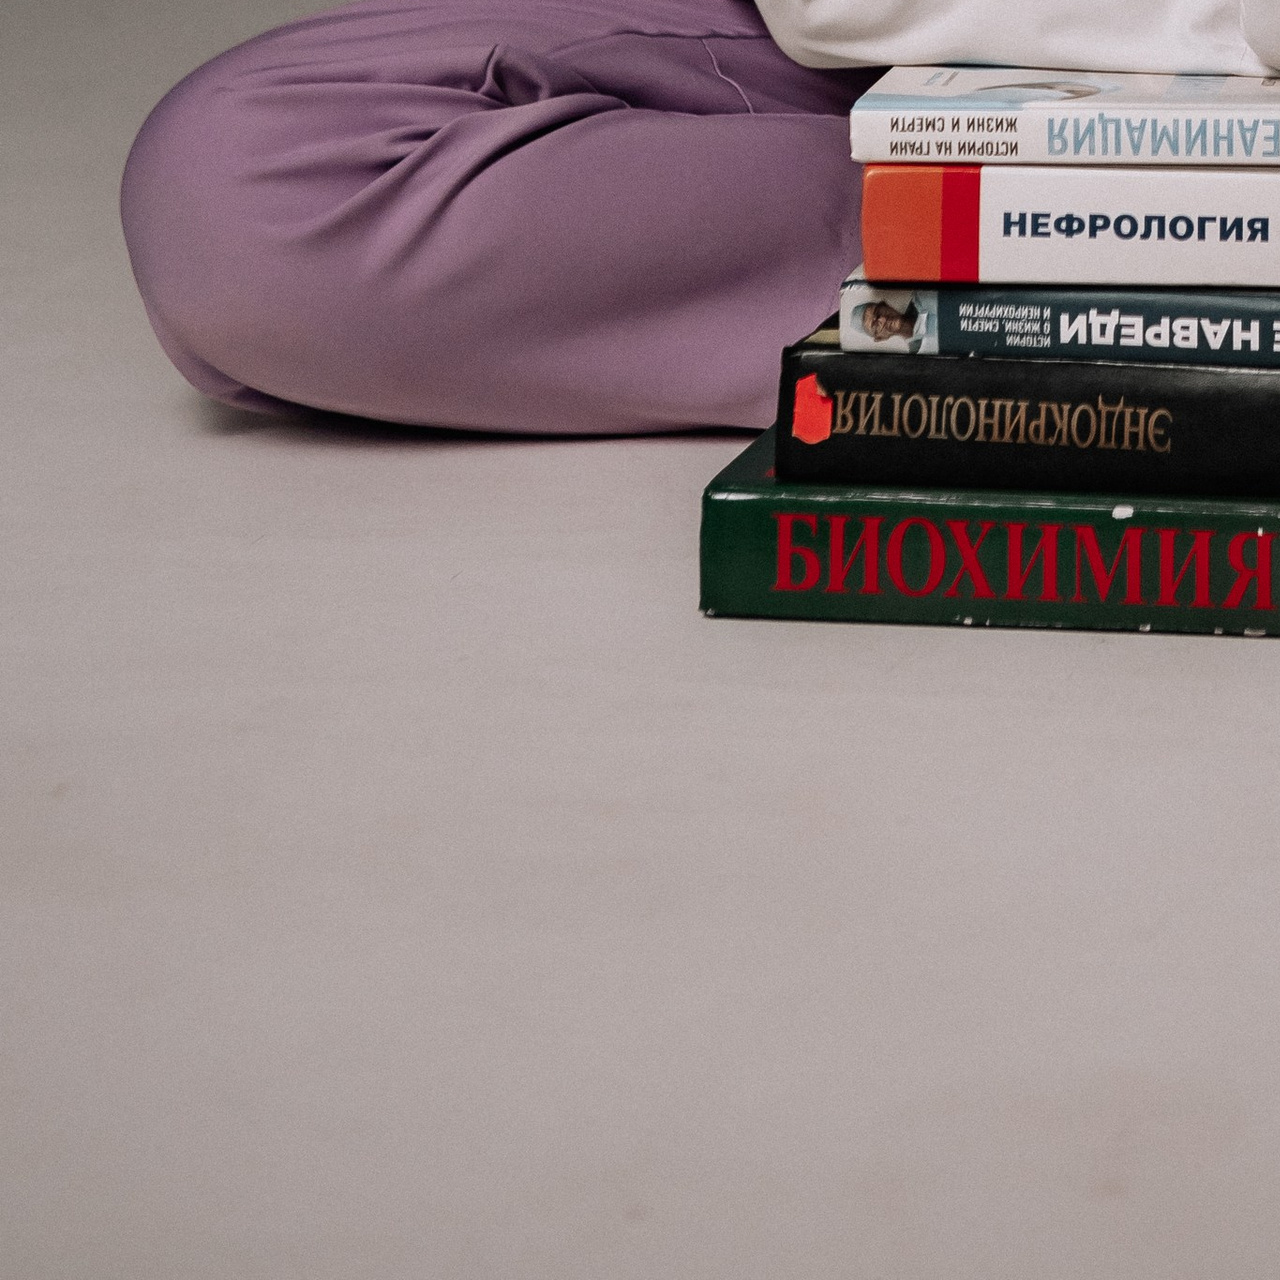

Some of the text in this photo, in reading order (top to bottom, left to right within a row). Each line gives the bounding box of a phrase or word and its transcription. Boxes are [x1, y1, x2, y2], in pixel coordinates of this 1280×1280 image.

[890, 116, 1018, 133] ЖИЗНИ И СМЕРТИ
[889, 141, 1019, 156] ИСТОРИИ НА ГРАНИ
[1003, 211, 1270, 244] НЕФРОЛОГИЯ
[959, 303, 1051, 321] И НЕЙРОХИРУРГИИ
[960, 318, 1051, 334] О ЖИЗНИ, СМЕРТИ
[1060, 307, 1260, 351] НАВРЕДИ
[1006, 334, 1051, 348] ИСТОРИИ
[834, 390, 1173, 453] ЭНДОКРИНОЛОГИЯ
[772, 512, 1278, 611] БИОХИМИЯ
